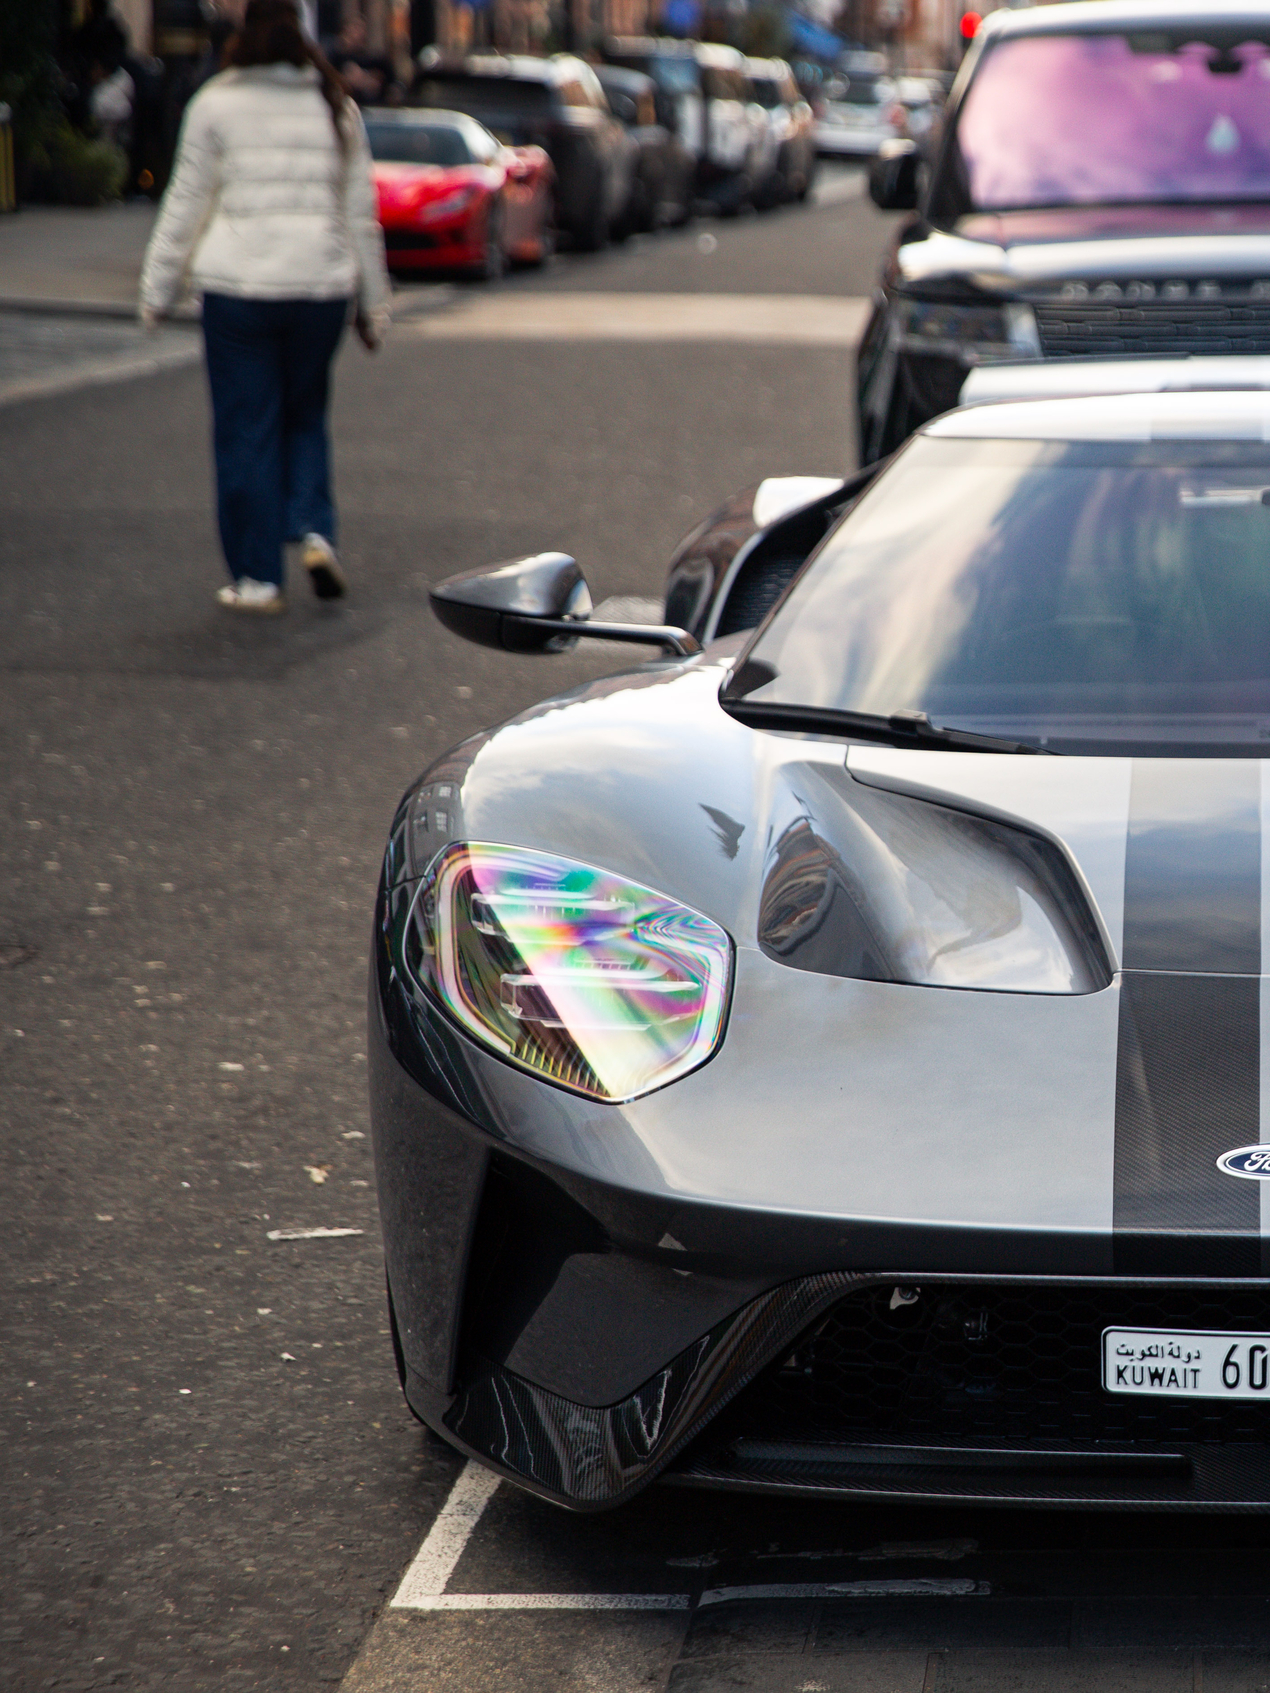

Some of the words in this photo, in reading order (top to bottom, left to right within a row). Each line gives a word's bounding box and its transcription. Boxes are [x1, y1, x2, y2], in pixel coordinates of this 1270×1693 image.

[1117, 1343, 1165, 1363] الكويت
[1168, 1341, 1201, 1364] دولة
[1117, 1365, 1201, 1389] KUWAIT
